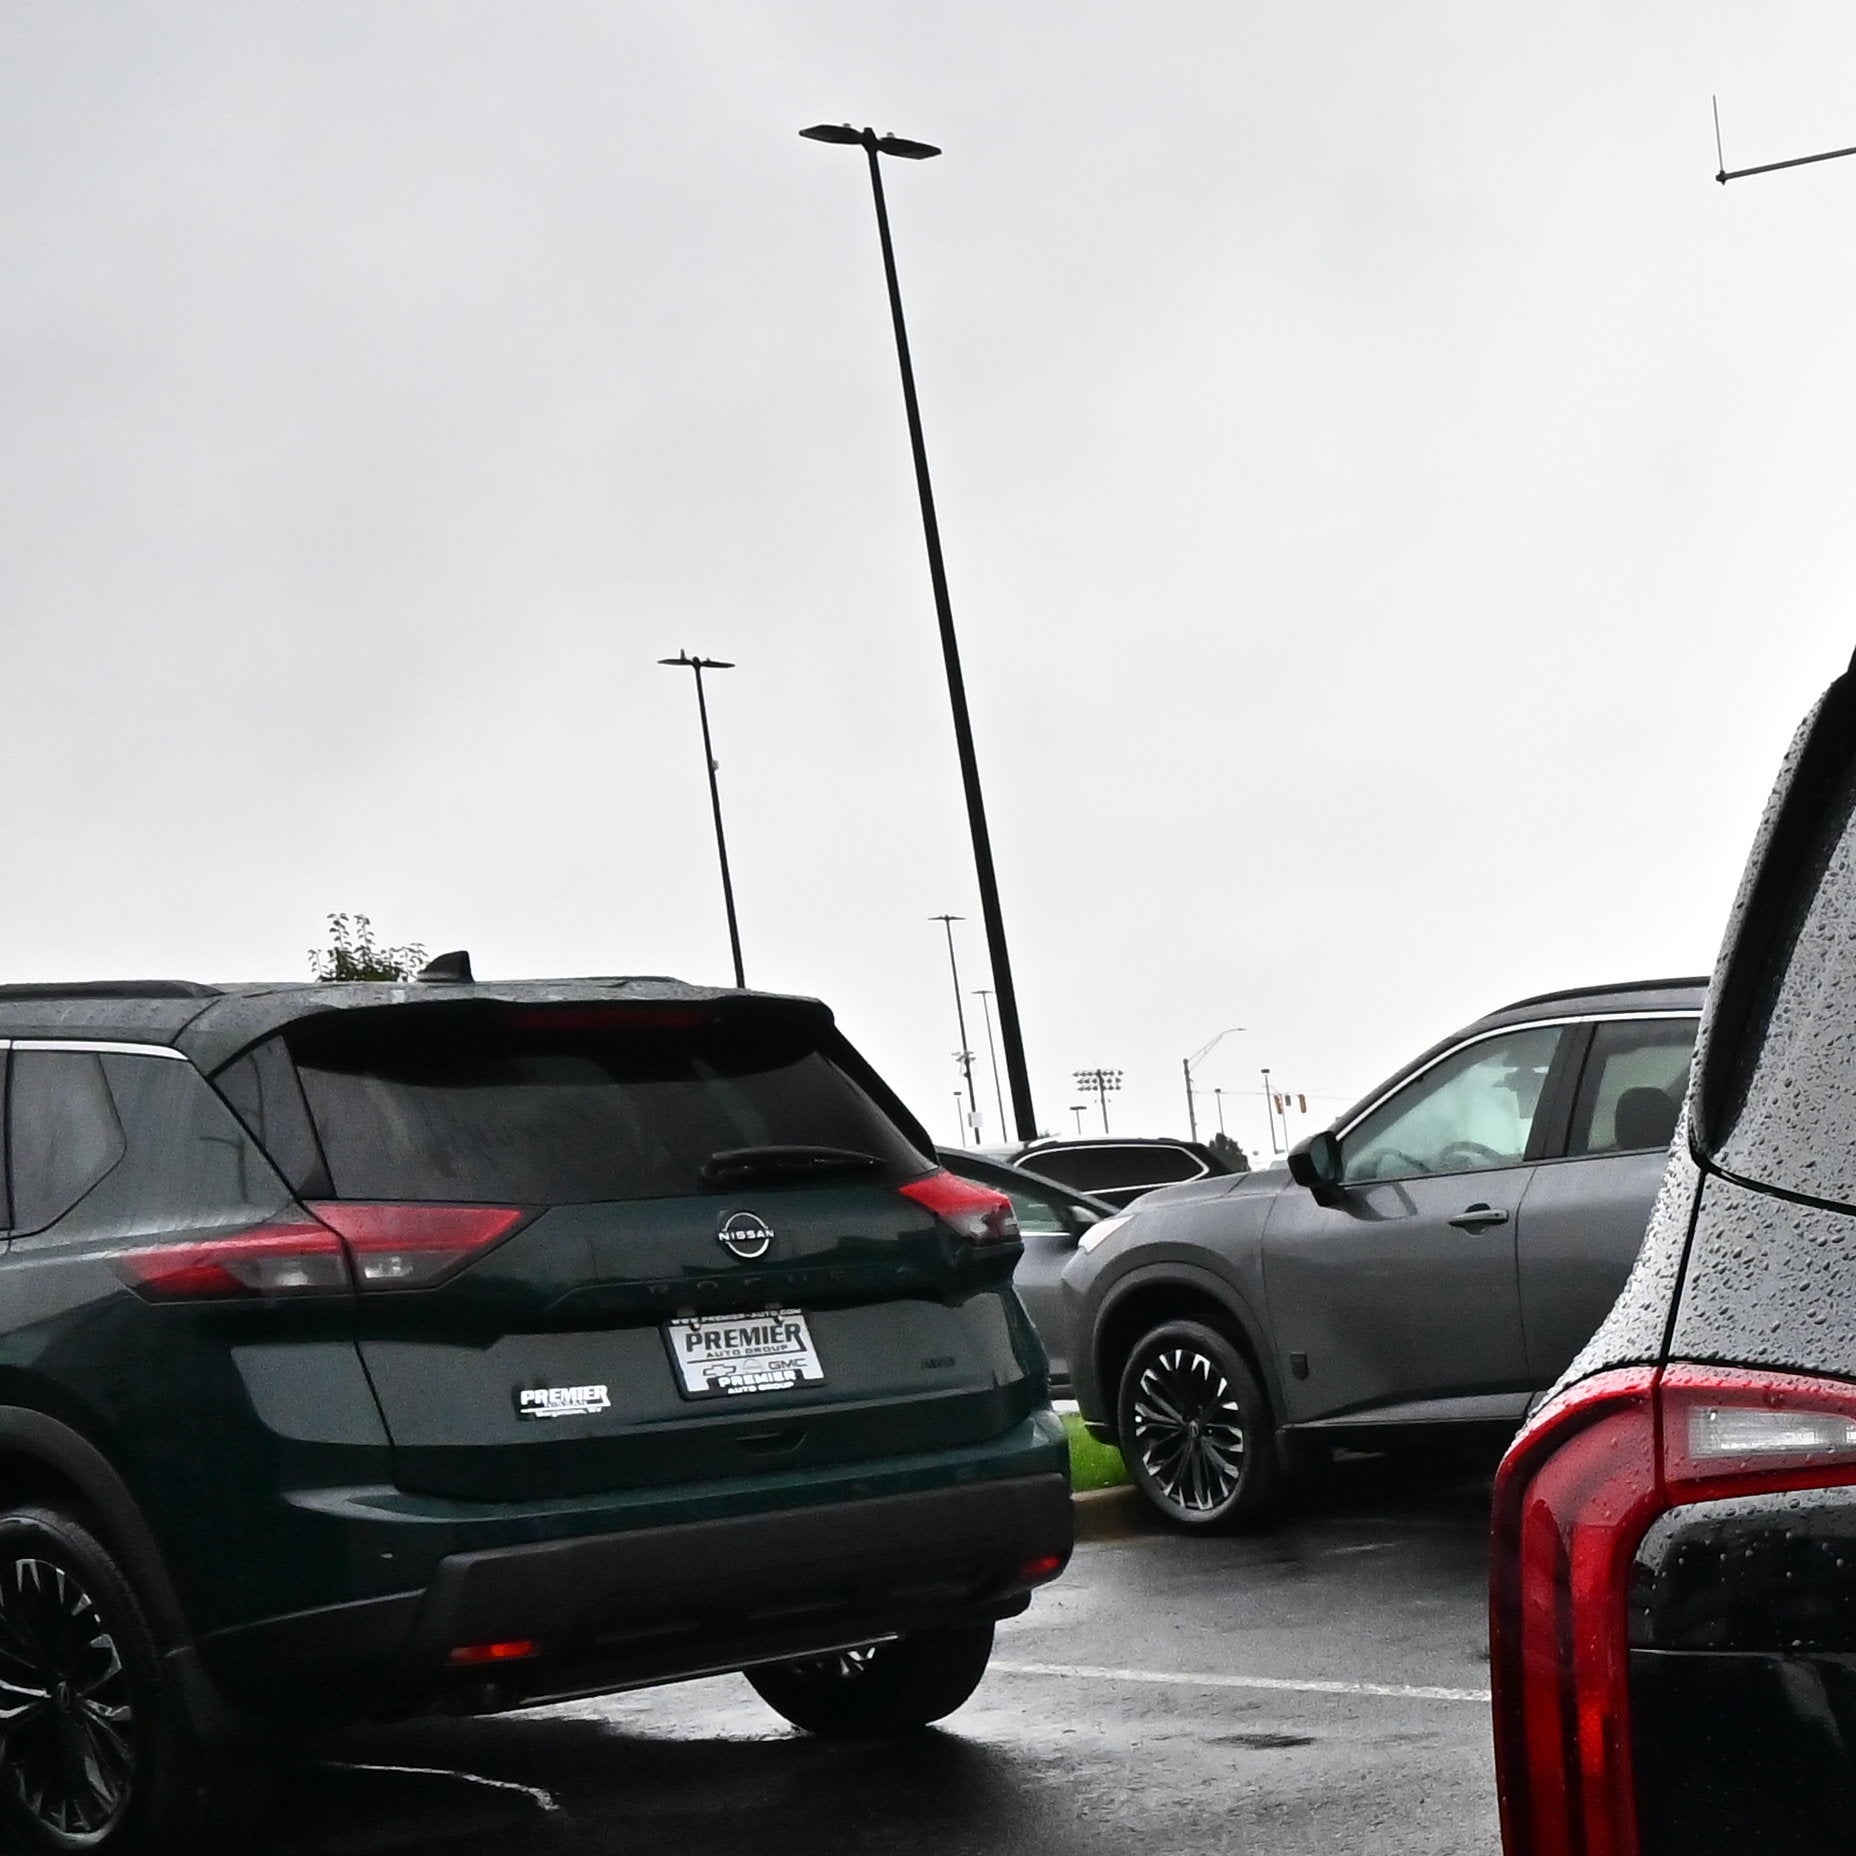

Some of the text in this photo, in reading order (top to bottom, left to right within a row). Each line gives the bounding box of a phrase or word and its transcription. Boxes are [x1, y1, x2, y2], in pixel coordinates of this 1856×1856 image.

[718, 1230, 774, 1241] NISSAN
[686, 1323, 806, 1352] PREMIER
[706, 1344, 789, 1359] AUTO GROUP
[768, 1358, 808, 1370] GMC
[719, 1370, 797, 1388] PREMIER
[520, 1385, 611, 1406] PREMIER
